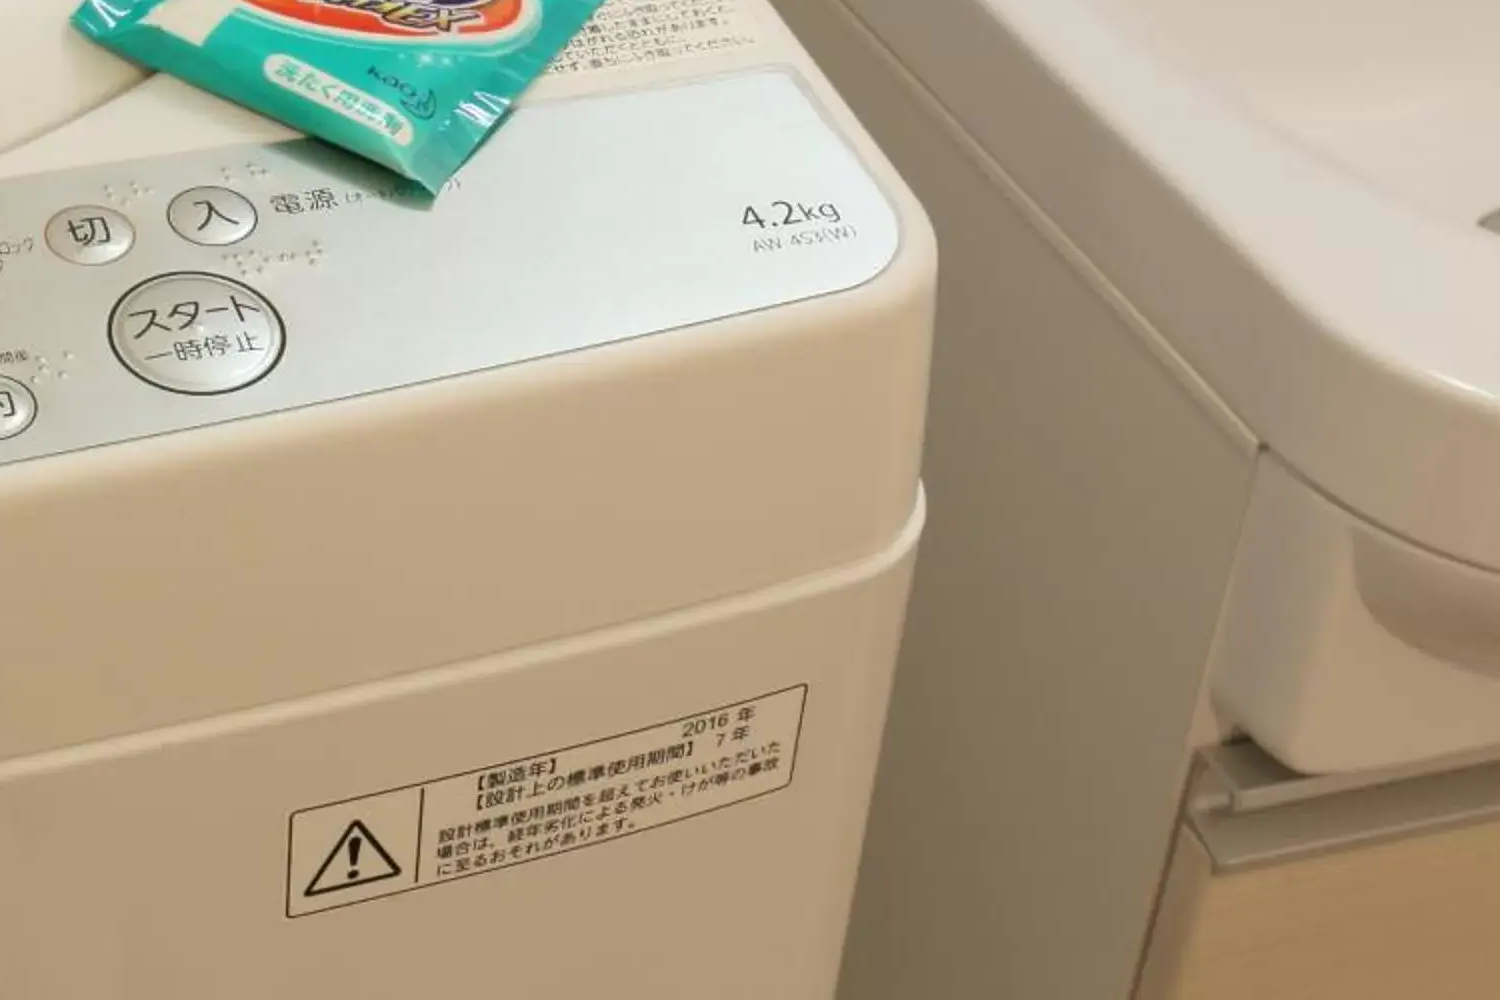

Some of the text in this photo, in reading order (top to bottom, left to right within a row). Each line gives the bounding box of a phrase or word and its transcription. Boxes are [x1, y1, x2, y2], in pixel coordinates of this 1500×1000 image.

[192, 200, 240, 232] 入
[270, 187, 340, 215] 電源
[742, 199, 841, 229] 4.2kg
[67, 217, 113, 247] 切
[127, 295, 261, 339] スタート
[144, 331, 265, 363] 一時停止
[477, 705, 756, 792] 【製造年】 2016 年
[476, 725, 751, 811] 【設計上の標準使用期間】 7 年
